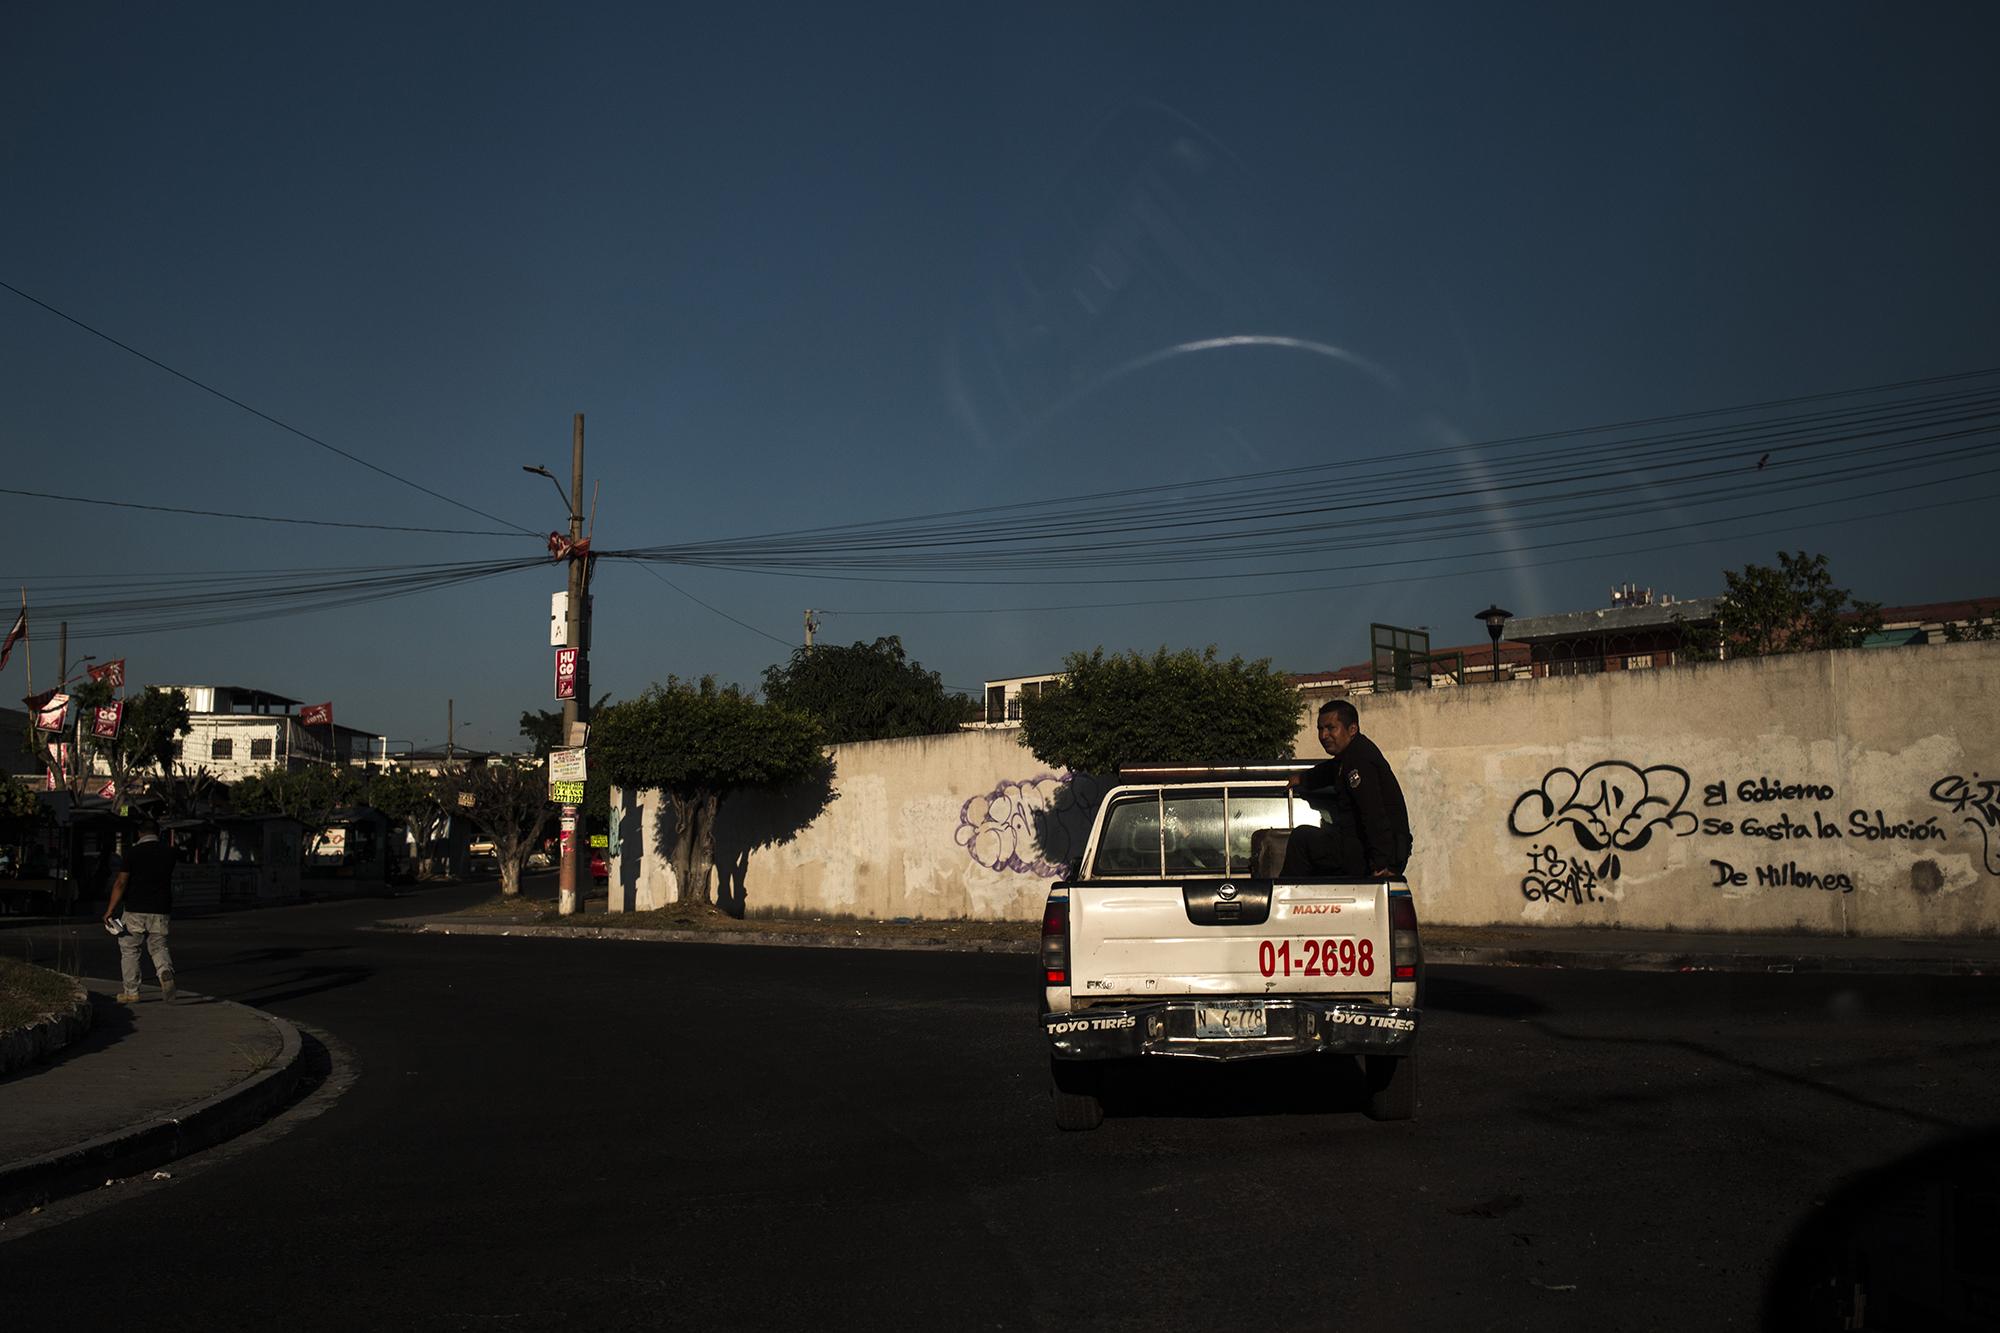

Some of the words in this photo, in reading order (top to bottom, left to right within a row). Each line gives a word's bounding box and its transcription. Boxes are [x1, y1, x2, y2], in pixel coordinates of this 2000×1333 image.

[560, 651, 575, 663] HU
[559, 663, 574, 675] GO
[1704, 780, 1728, 807] El
[1737, 777, 1834, 803] Gobierno
[1740, 813, 1813, 841] Gasta
[1814, 811, 1843, 840] la
[1848, 809, 1947, 841] Solución
[1710, 859, 1748, 888] De
[1755, 861, 1854, 894] Millones
[1259, 939, 1375, 977] 01-2698
[1046, 1020, 1089, 1035] TOYO
[1091, 1016, 1136, 1031] TIRES
[1198, 1010, 1206, 1028] N
[1325, 1011, 1367, 1025] TOYO
[1369, 1016, 1416, 1031] TIRES
